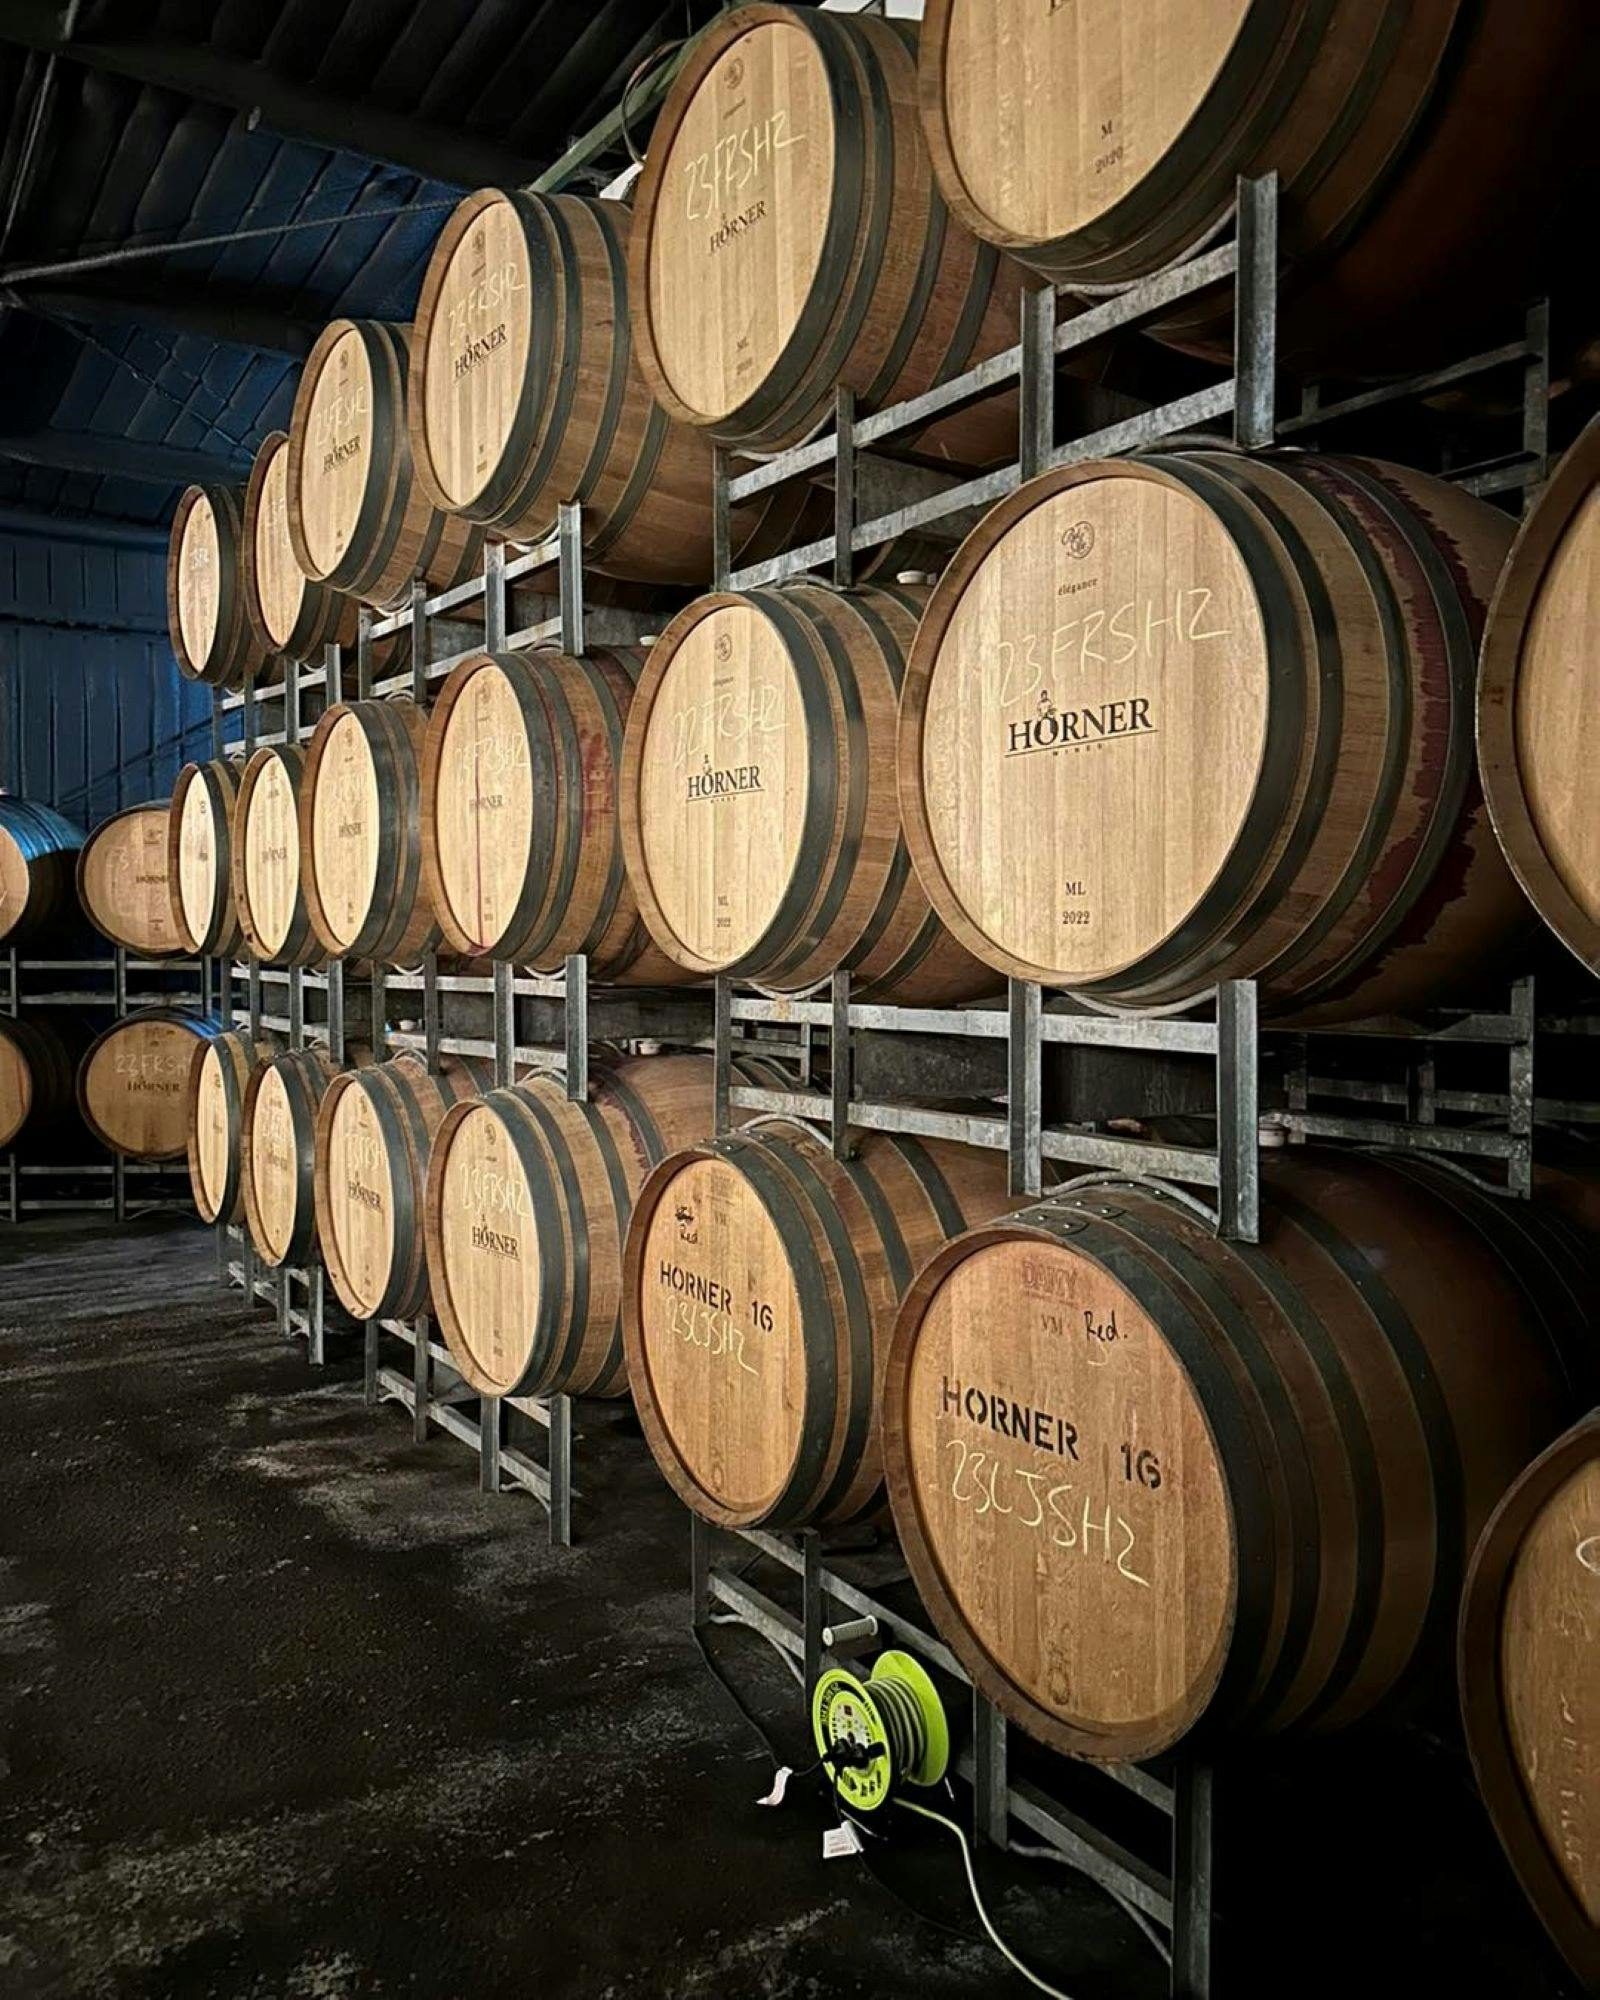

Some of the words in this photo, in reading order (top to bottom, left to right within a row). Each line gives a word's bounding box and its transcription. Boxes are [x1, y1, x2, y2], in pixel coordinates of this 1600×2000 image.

[1062, 910, 1091, 925] 2022
[660, 1259, 732, 1315] HORNER
[752, 1300, 774, 1332] 16
[940, 1375, 1079, 1461] HORNER
[1120, 1443, 1162, 1490] 16
